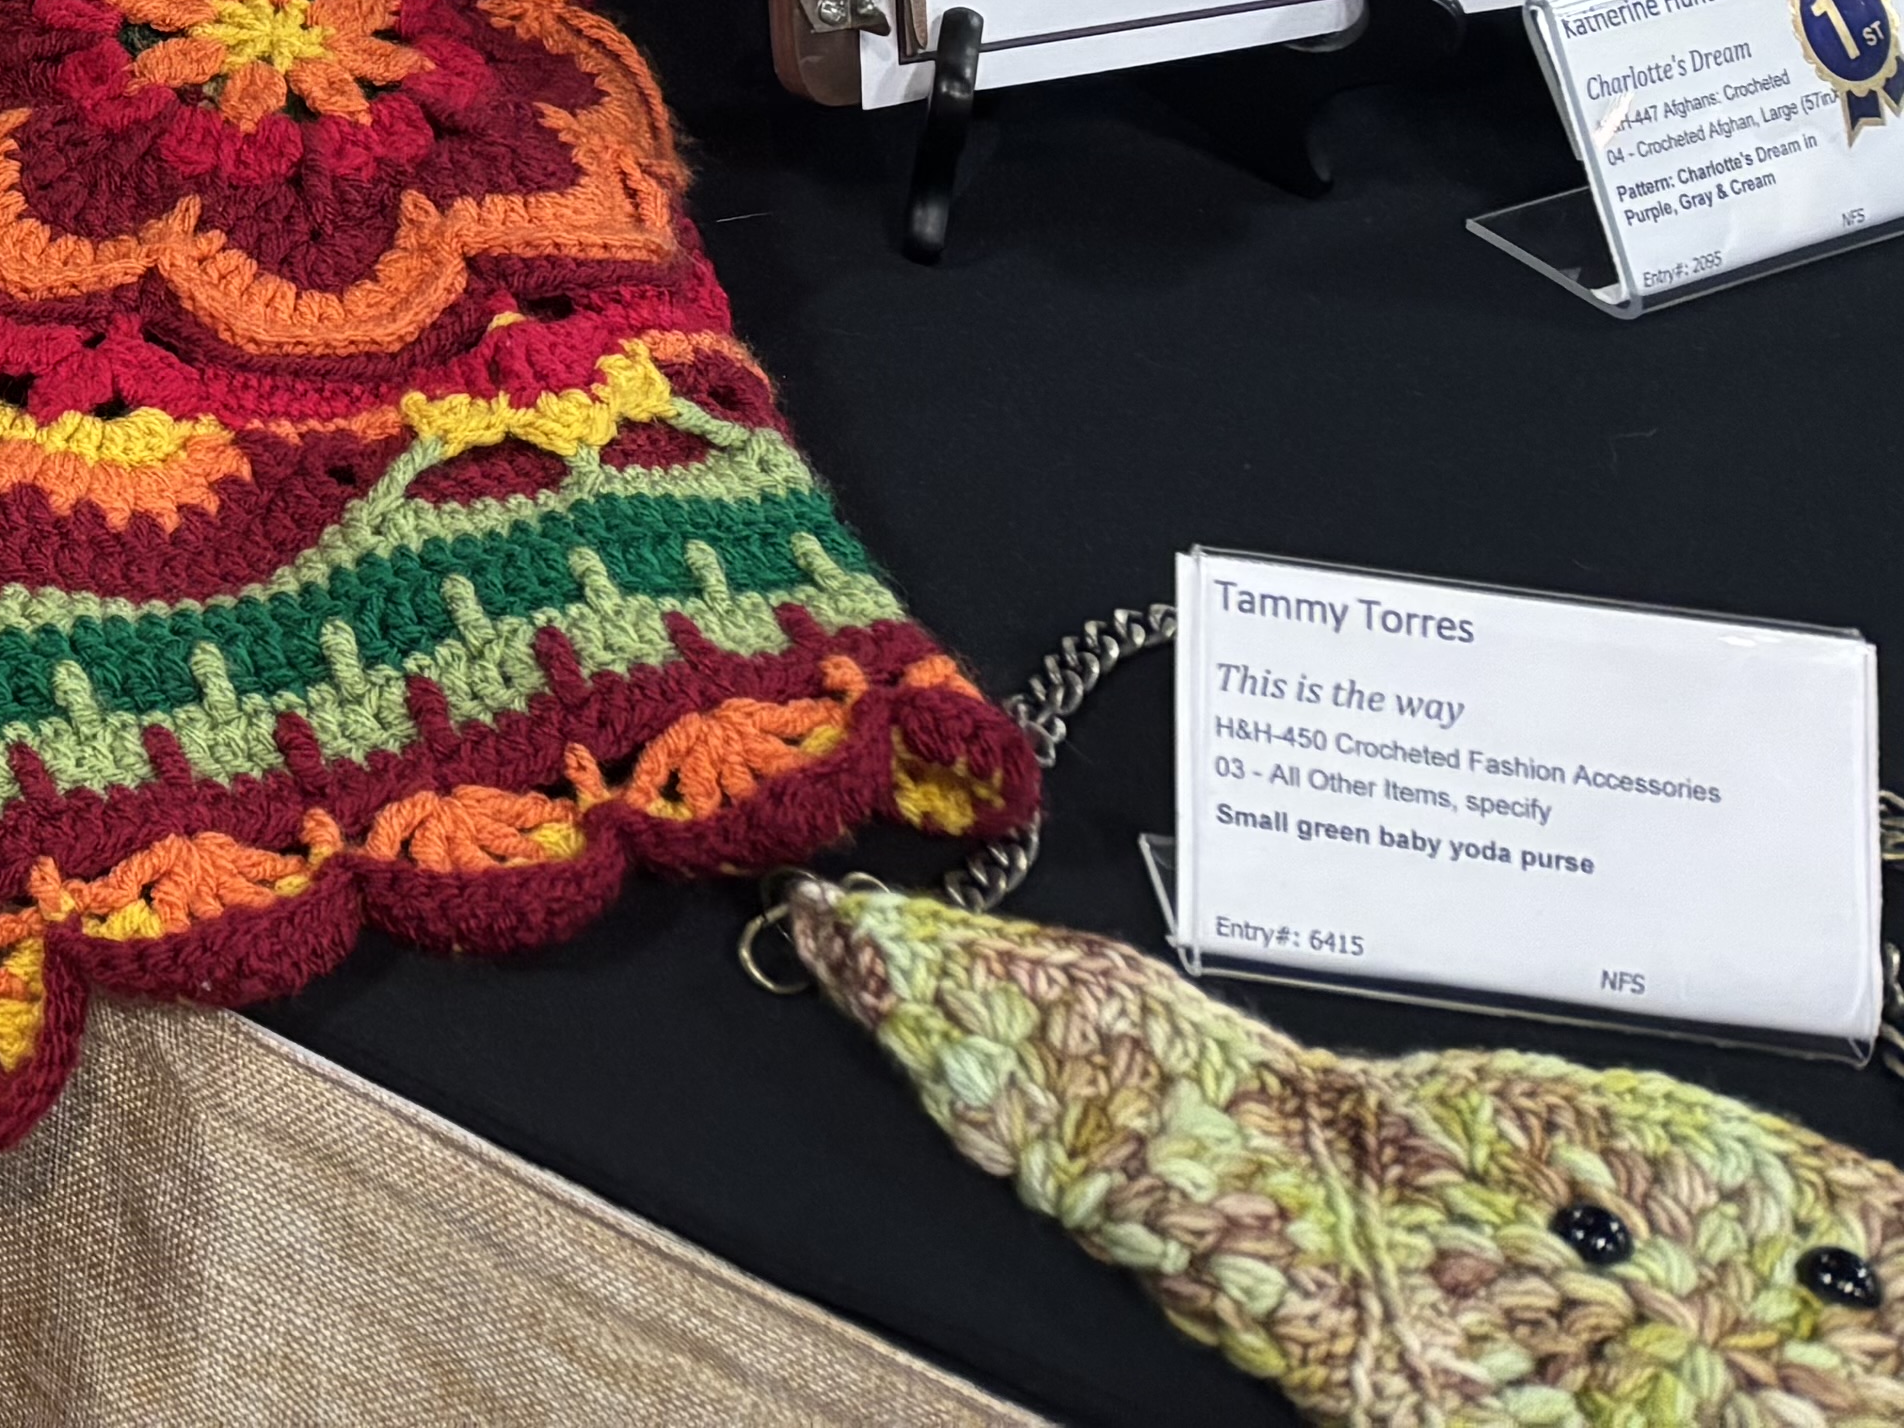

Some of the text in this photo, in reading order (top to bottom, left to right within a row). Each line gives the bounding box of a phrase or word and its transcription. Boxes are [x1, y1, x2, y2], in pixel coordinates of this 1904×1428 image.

[1586, 41, 1753, 101] Charlotte's Dream
[1615, 134, 1818, 203] Pattern: Charlotte's Dream in
[1623, 172, 1777, 227] Purple, Gray & Cream
[1213, 578, 1474, 643] Tammy Torres
[1216, 662, 1466, 730] This is the way
[1214, 755, 1552, 827] 03 All Other Items, specify
[1215, 715, 1722, 804] H&H-450 Crocheted Fashion Accessories
[1215, 802, 1595, 875] Small green baby yoda purse
[1215, 914, 1364, 956] Entry#: 6415
[1600, 968, 1646, 994] NFS
